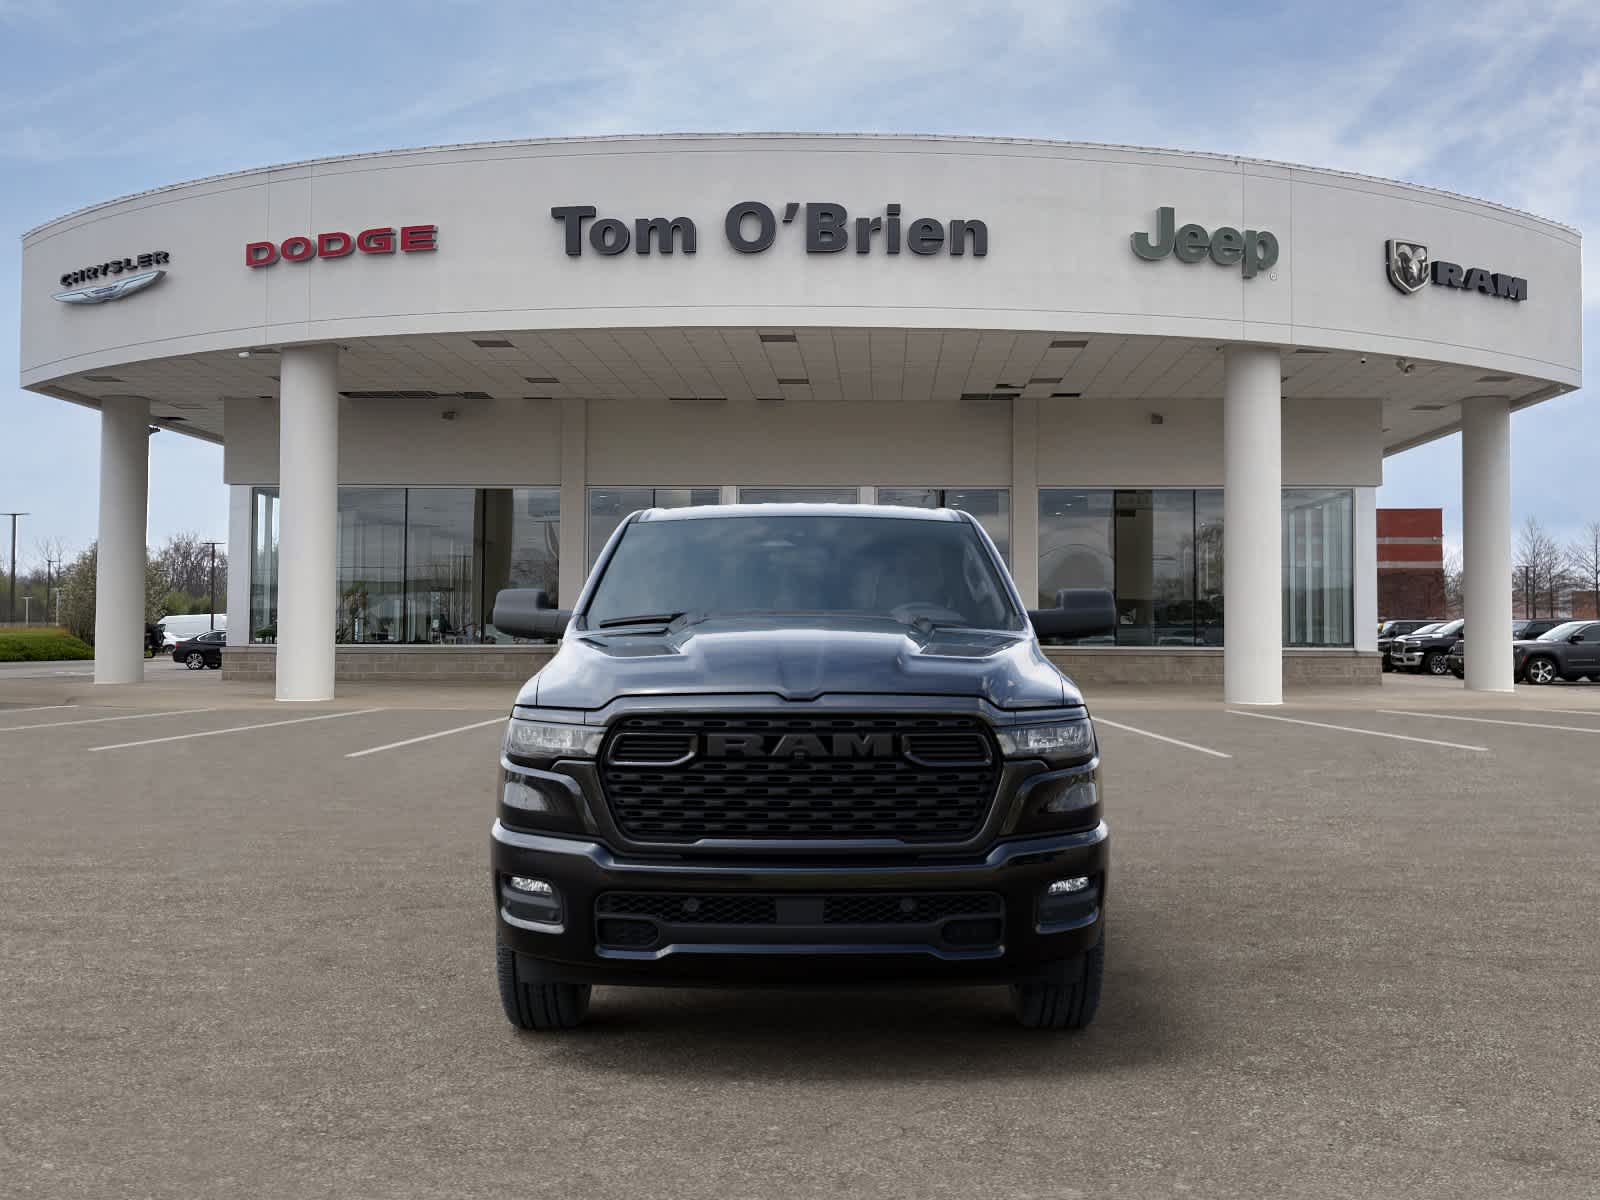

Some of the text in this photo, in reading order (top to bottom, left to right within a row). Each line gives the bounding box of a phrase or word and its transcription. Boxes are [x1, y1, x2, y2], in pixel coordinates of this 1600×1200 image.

[245, 225, 437, 269] DODGE
[551, 202, 988, 257] Tom O'Brien
[1130, 206, 1279, 279] Jeep
[60, 250, 169, 286] CHRYSLER
[1431, 260, 1527, 301] RAM
[705, 733, 893, 757] RAM
